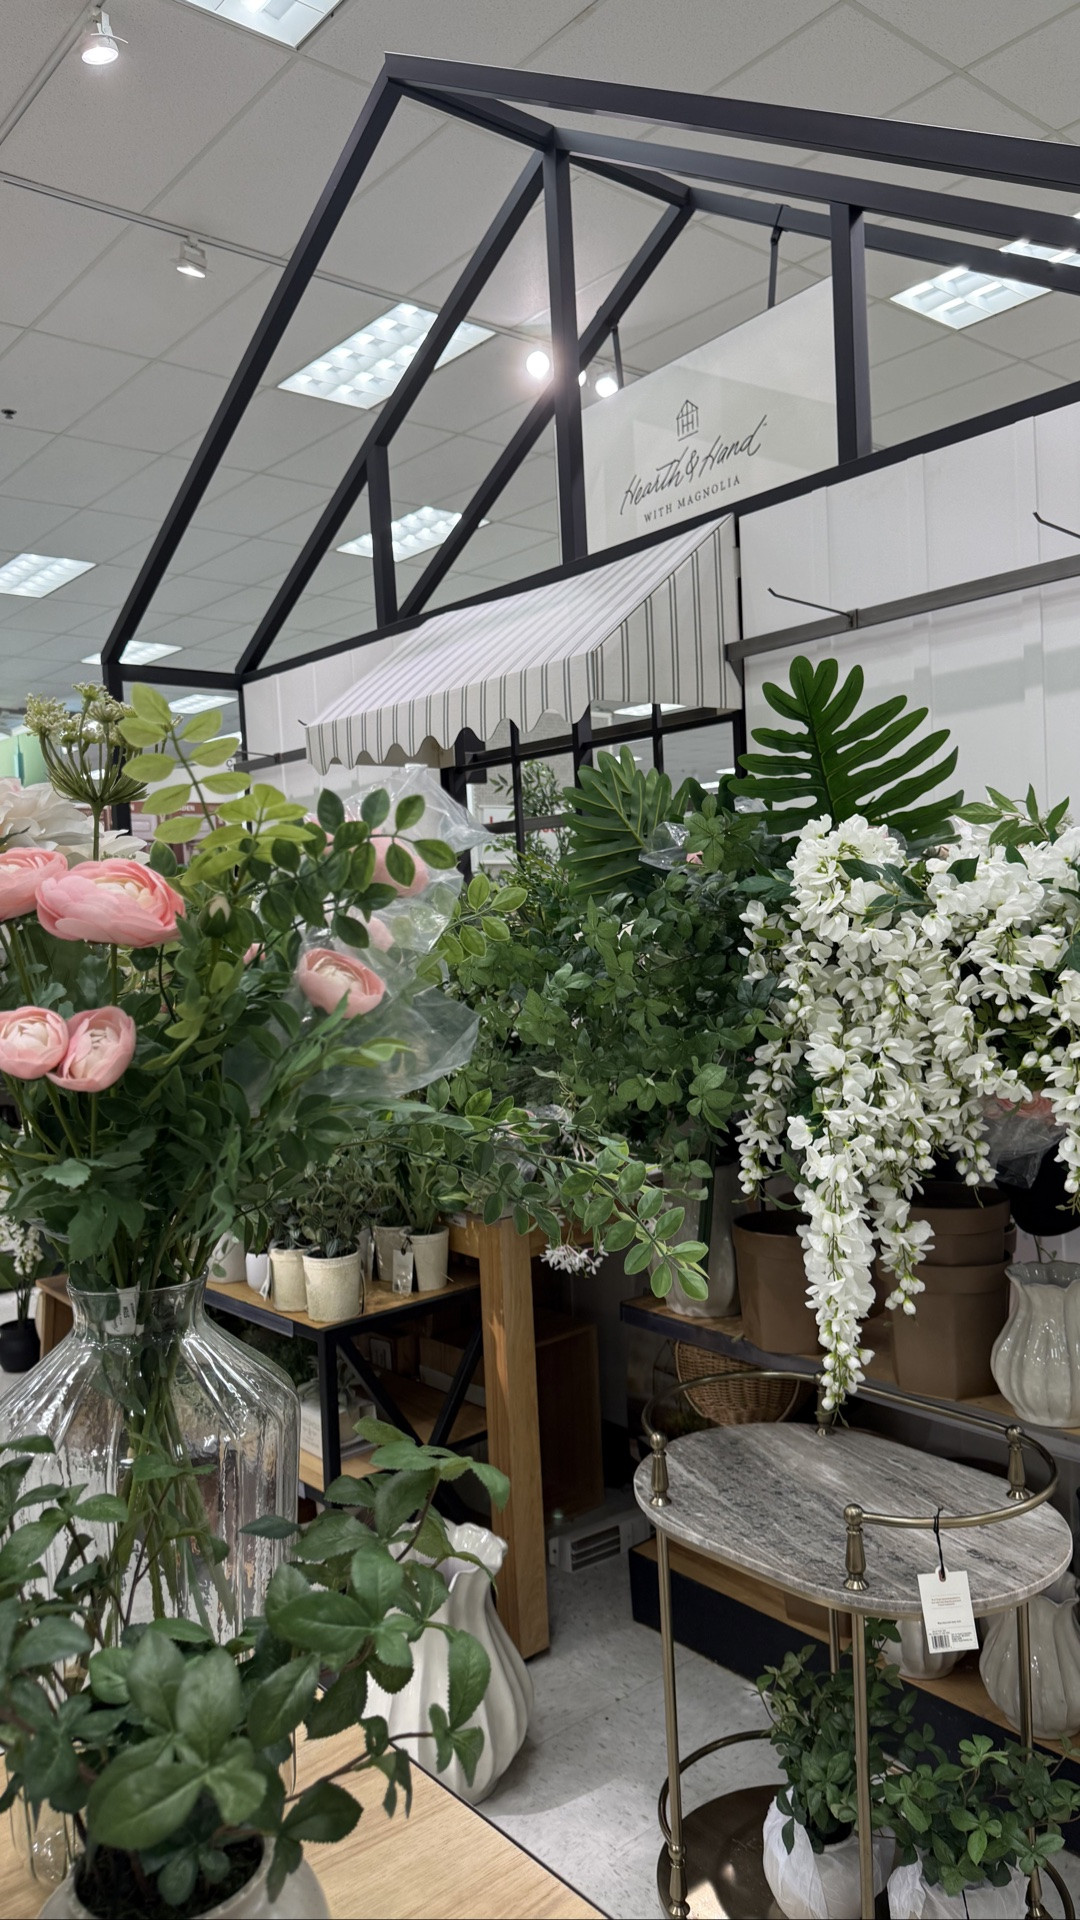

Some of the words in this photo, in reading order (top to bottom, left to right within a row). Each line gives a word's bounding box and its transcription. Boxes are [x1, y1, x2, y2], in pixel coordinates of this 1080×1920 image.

[620, 446, 688, 515] Hearth
[685, 450, 700, 482] &
[699, 415, 767, 478] Hand
[643, 503, 673, 523] WITH
[677, 475, 741, 510] MAGNOLIA
